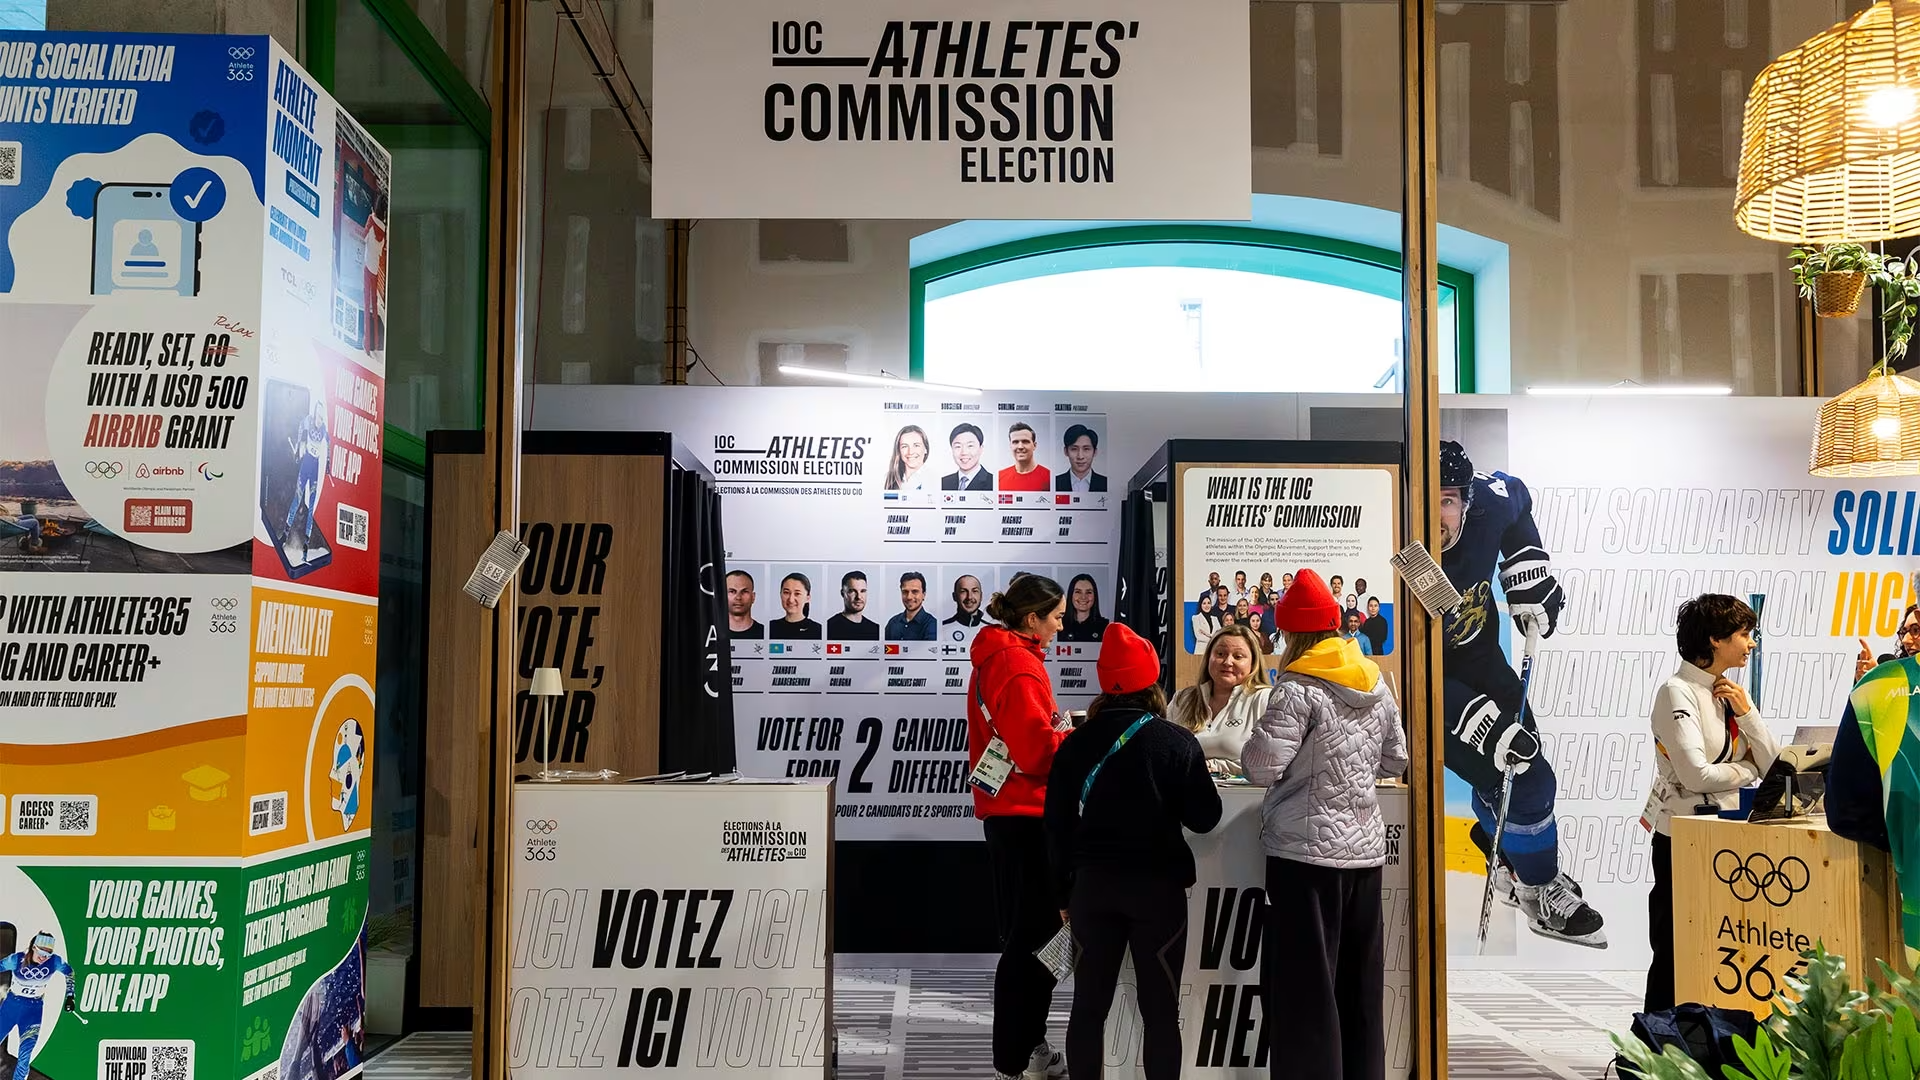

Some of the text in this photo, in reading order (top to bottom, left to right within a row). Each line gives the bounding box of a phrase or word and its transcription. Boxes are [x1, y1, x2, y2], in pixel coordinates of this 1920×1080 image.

[36, 43, 108, 80] SOCIAL
[107, 44, 175, 82] MEDIA
[772, 20, 1139, 79] IOC ATHLETES'
[227, 69, 253, 81] 365
[51, 87, 137, 125] VERIFIED
[274, 58, 318, 135] ATHLETE
[764, 83, 1113, 142] COMMISSION
[272, 108, 323, 187] MOMENT
[961, 147, 1114, 183] ELECTION
[213, 315, 254, 338] Relax
[87, 331, 154, 370] READY,
[158, 332, 195, 371] SET,
[87, 373, 249, 409] WITH A USD 500
[83, 413, 235, 449] AIRBNB GRANT
[714, 435, 871, 459] IOC ATHLETES'
[152, 466, 185, 476] airbnb
[714, 459, 862, 476] COMMISSION ELECTION
[1206, 476, 1313, 501] WHAT IS THE IOC
[1273, 505, 1362, 528] COMMISSION
[1602, 487, 1825, 555] SOLIDARITY
[1827, 490, 1920, 555] SOLI
[7, 595, 67, 634] WITH
[64, 596, 191, 636] ATHLETE365
[1550, 568, 1615, 636] ON
[209, 621, 236, 633] 365
[256, 600, 334, 657] MENTALLY FIT
[18, 642, 161, 682] AND CAREER+
[518, 606, 604, 689] OTE,
[11, 691, 30, 707] AND
[31, 691, 47, 707] OFF
[47, 691, 62, 707] THE
[61, 692, 83, 707] FIELD
[83, 692, 96, 707] OF
[94, 692, 117, 708] PLAY.
[1529, 650, 1665, 718] UALITY
[757, 716, 969, 794] VOTE FOR 2 CANDID
[19, 817, 50, 830] CAREER+
[20, 800, 54, 817] ACCESS
[723, 820, 781, 831] ÉLECTIONS À LA
[835, 804, 963, 818] POUR 2 CANDIDATS DE 2 SPORTS
[524, 847, 556, 861] 365
[527, 838, 556, 846] Athlete
[723, 831, 807, 845] COMMISSION
[727, 845, 786, 862] ATHLÈTES
[794, 847, 806, 856] CIO
[86, 880, 217, 924] YOUR GAMES,
[512, 888, 808, 969] ICI VOTEZ ICI
[1717, 915, 1810, 952] Athlete
[84, 926, 141, 966] YOUR
[139, 926, 225, 971] PHOTOS,
[80, 973, 170, 1013] ONE APP
[508, 987, 617, 1068] OTEZ
[617, 987, 691, 1068] ICI
[105, 1046, 147, 1061] DOWNLOAD
[105, 1062, 146, 1080] THE APP
